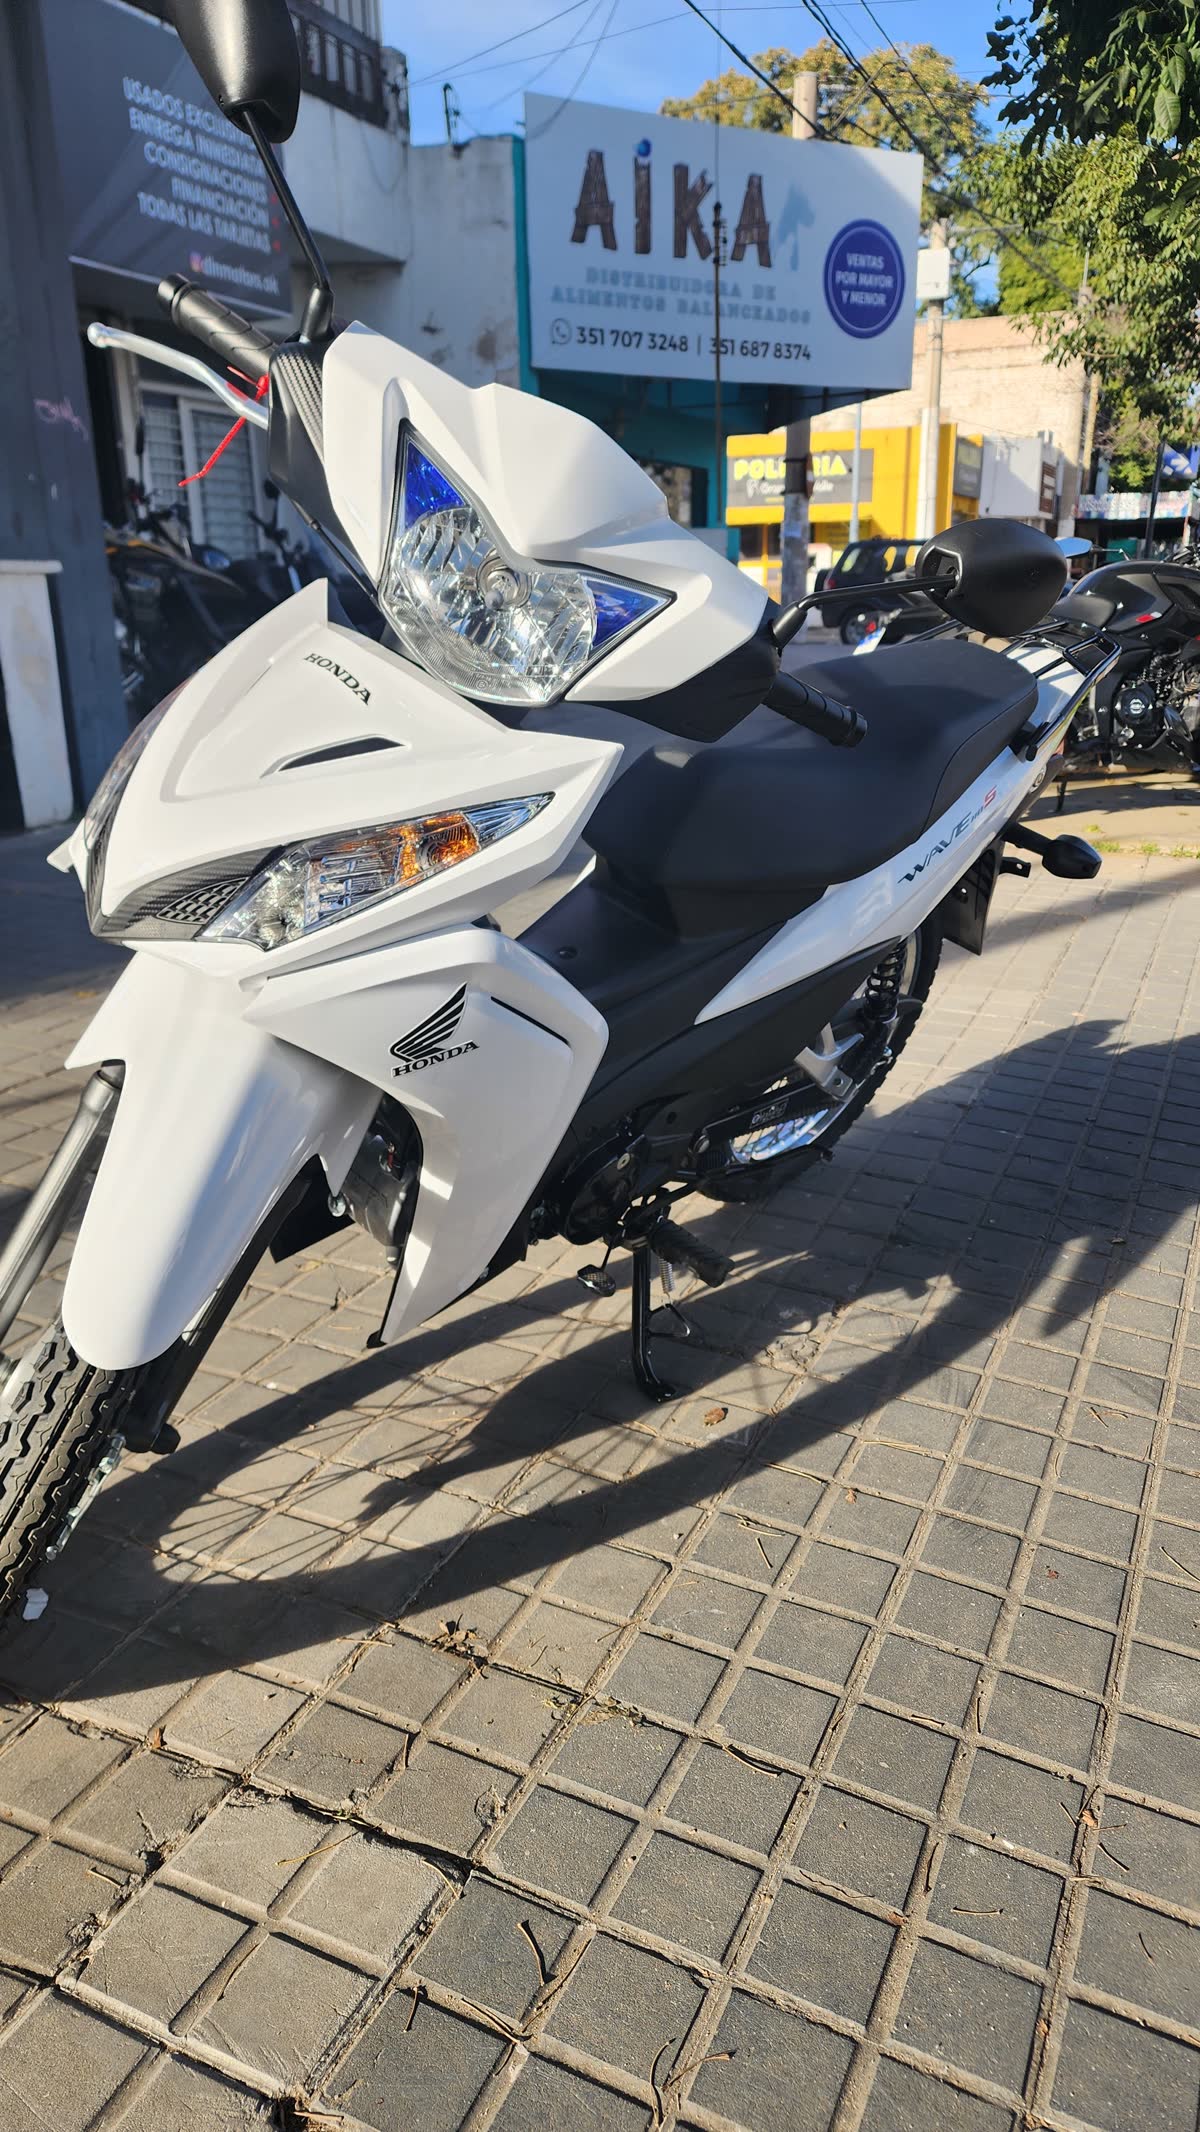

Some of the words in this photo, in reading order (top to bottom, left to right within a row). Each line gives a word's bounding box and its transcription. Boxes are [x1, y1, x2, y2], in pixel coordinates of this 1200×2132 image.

[123, 76, 184, 120] USADOS
[129, 107, 195, 151] ENTREGA
[137, 191, 187, 228] TODAS
[187, 209, 213, 236] LAS
[835, 270, 857, 284] POR
[858, 273, 893, 288] MAYOR
[846, 253, 884, 270] VENTAS
[586, 267, 741, 298] DISTRIBUIDORA
[752, 284, 776, 301] DE
[841, 290, 850, 304] Y
[850, 291, 886, 306] MENOR
[551, 286, 666, 312] ALIMENTOS
[677, 298, 811, 324] BALANCEADOS
[576, 326, 604, 346] 351
[610, 329, 643, 349] 707
[647, 332, 689, 352] 3248
[710, 337, 735, 355] 351
[740, 340, 770, 358] 687
[774, 342, 811, 360] 8374
[304, 653, 371, 705] HONDA
[898, 811, 972, 883] WAVE
[391, 1041, 480, 1077] HONDA
